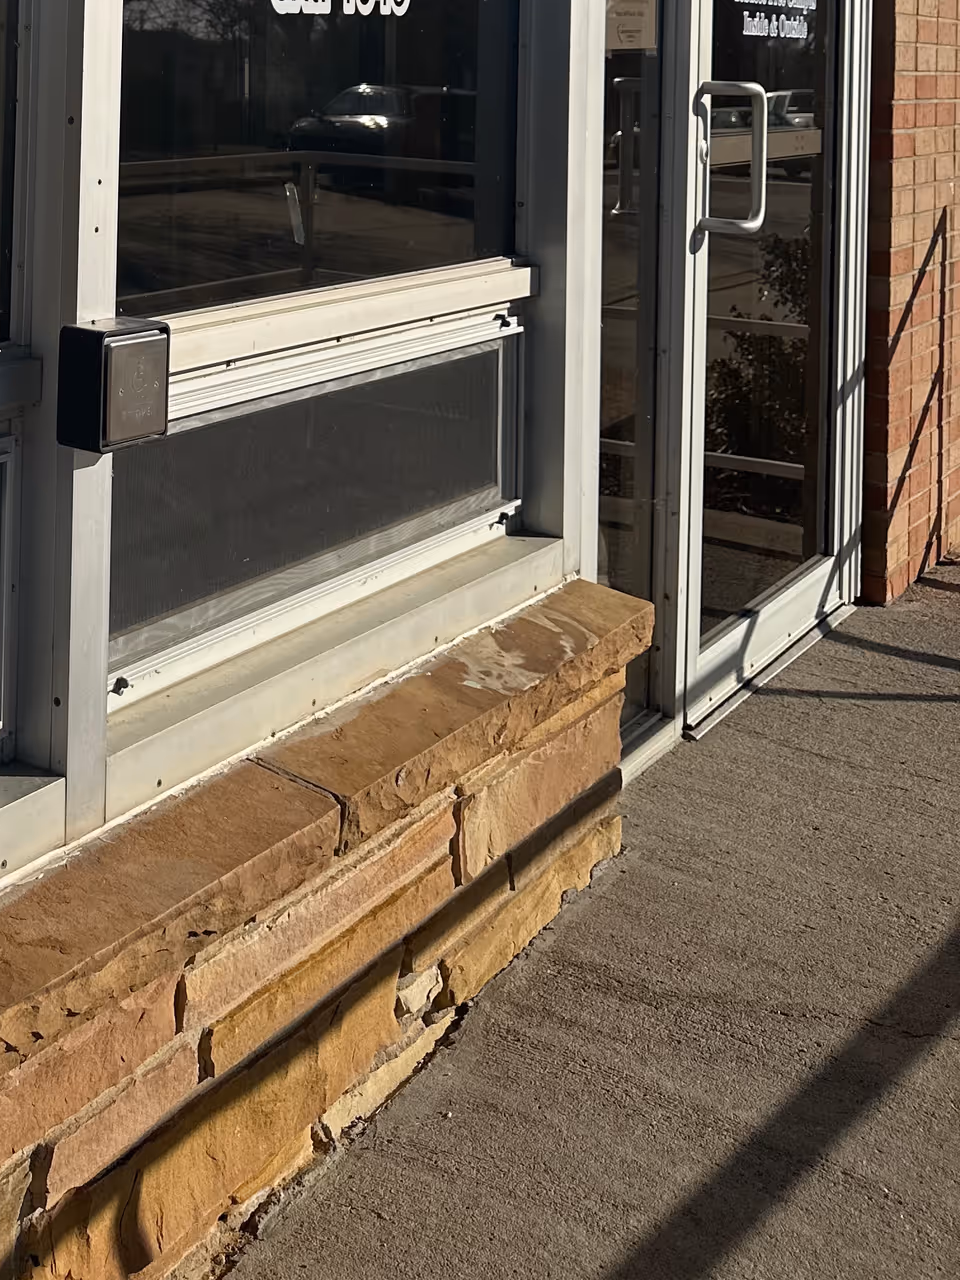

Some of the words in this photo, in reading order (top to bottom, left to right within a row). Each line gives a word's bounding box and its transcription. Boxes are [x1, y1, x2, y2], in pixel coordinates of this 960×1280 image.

[742, 10, 769, 37] Inside
[769, 14, 778, 37] &
[778, 14, 808, 39] Outside
